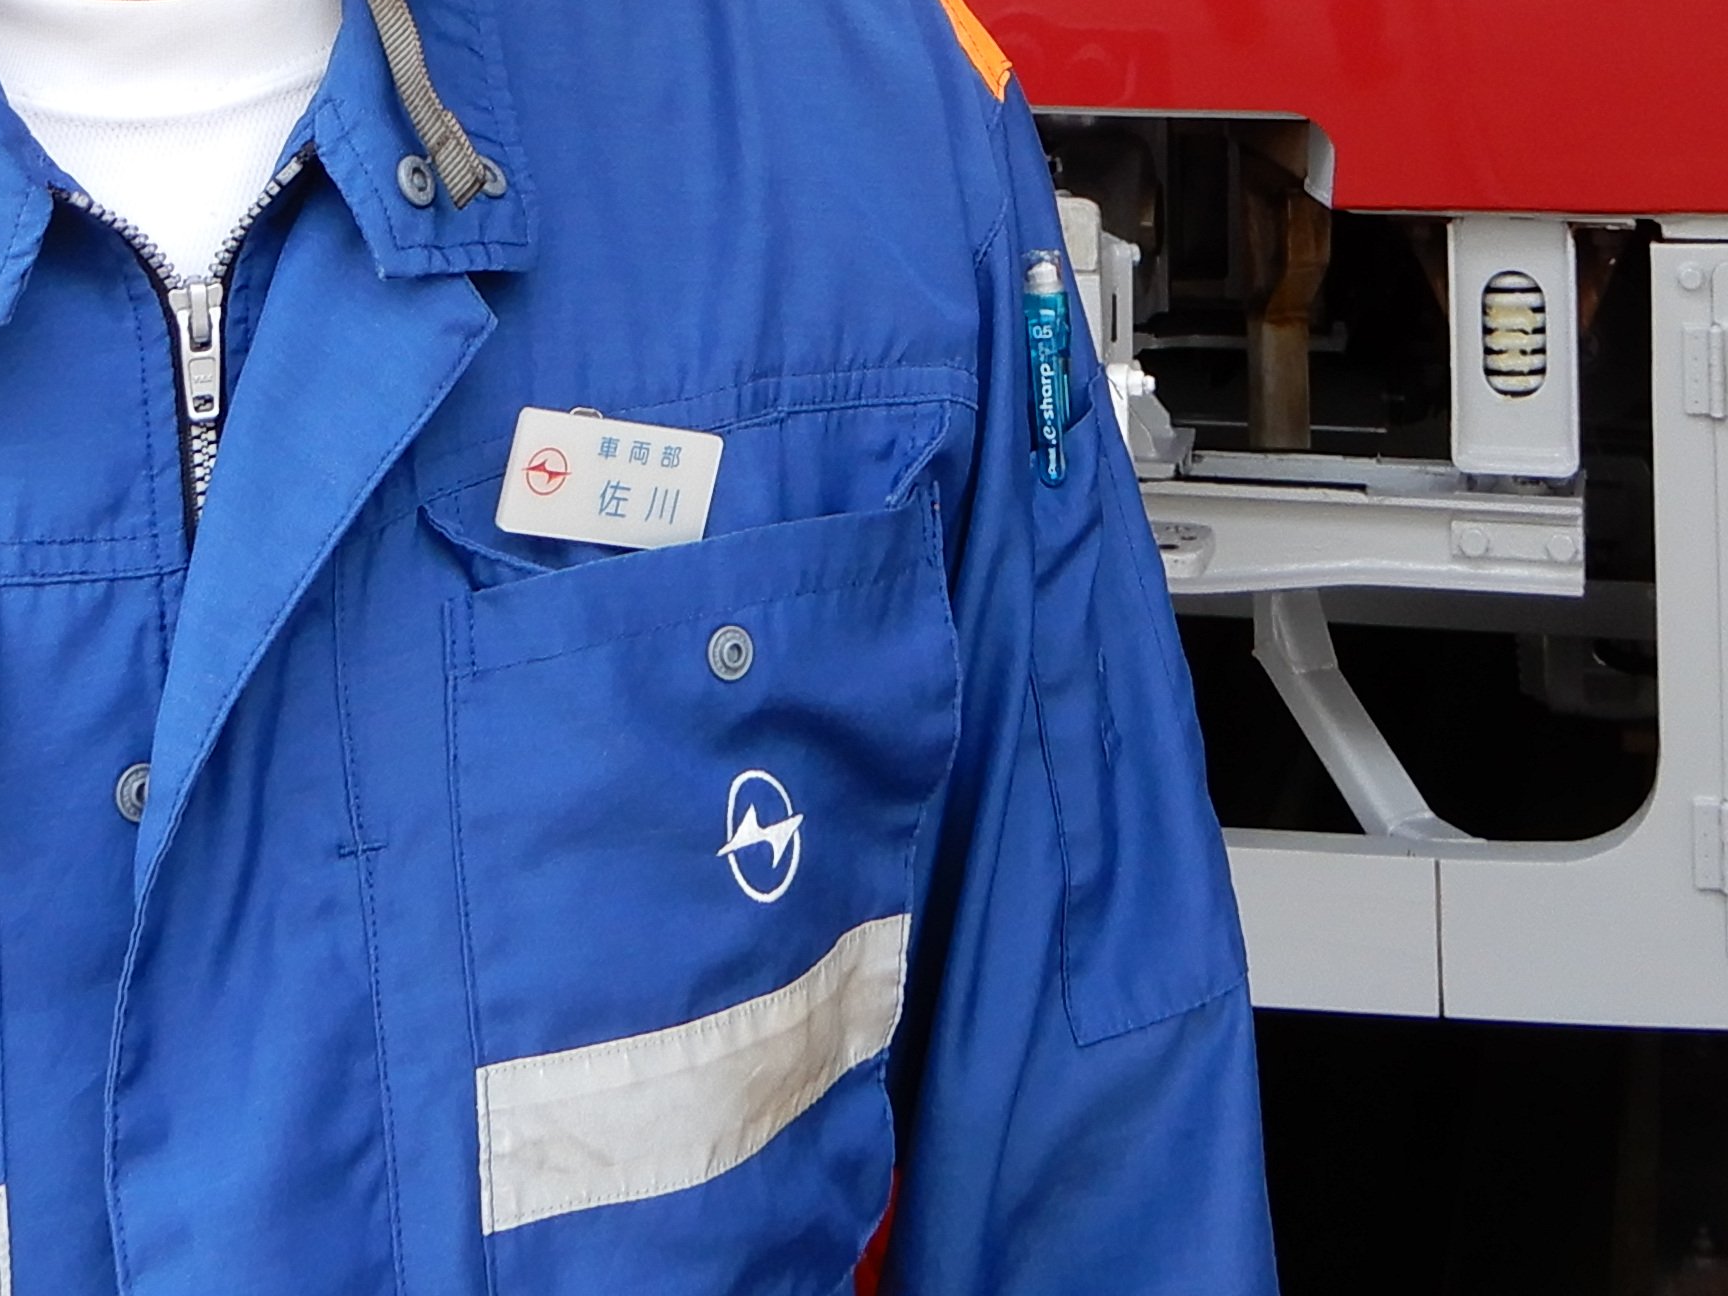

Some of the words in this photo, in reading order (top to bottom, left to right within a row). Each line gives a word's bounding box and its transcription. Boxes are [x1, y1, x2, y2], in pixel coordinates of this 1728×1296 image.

[597, 436, 683, 469] 車両部
[598, 479, 681, 525] 佐川
